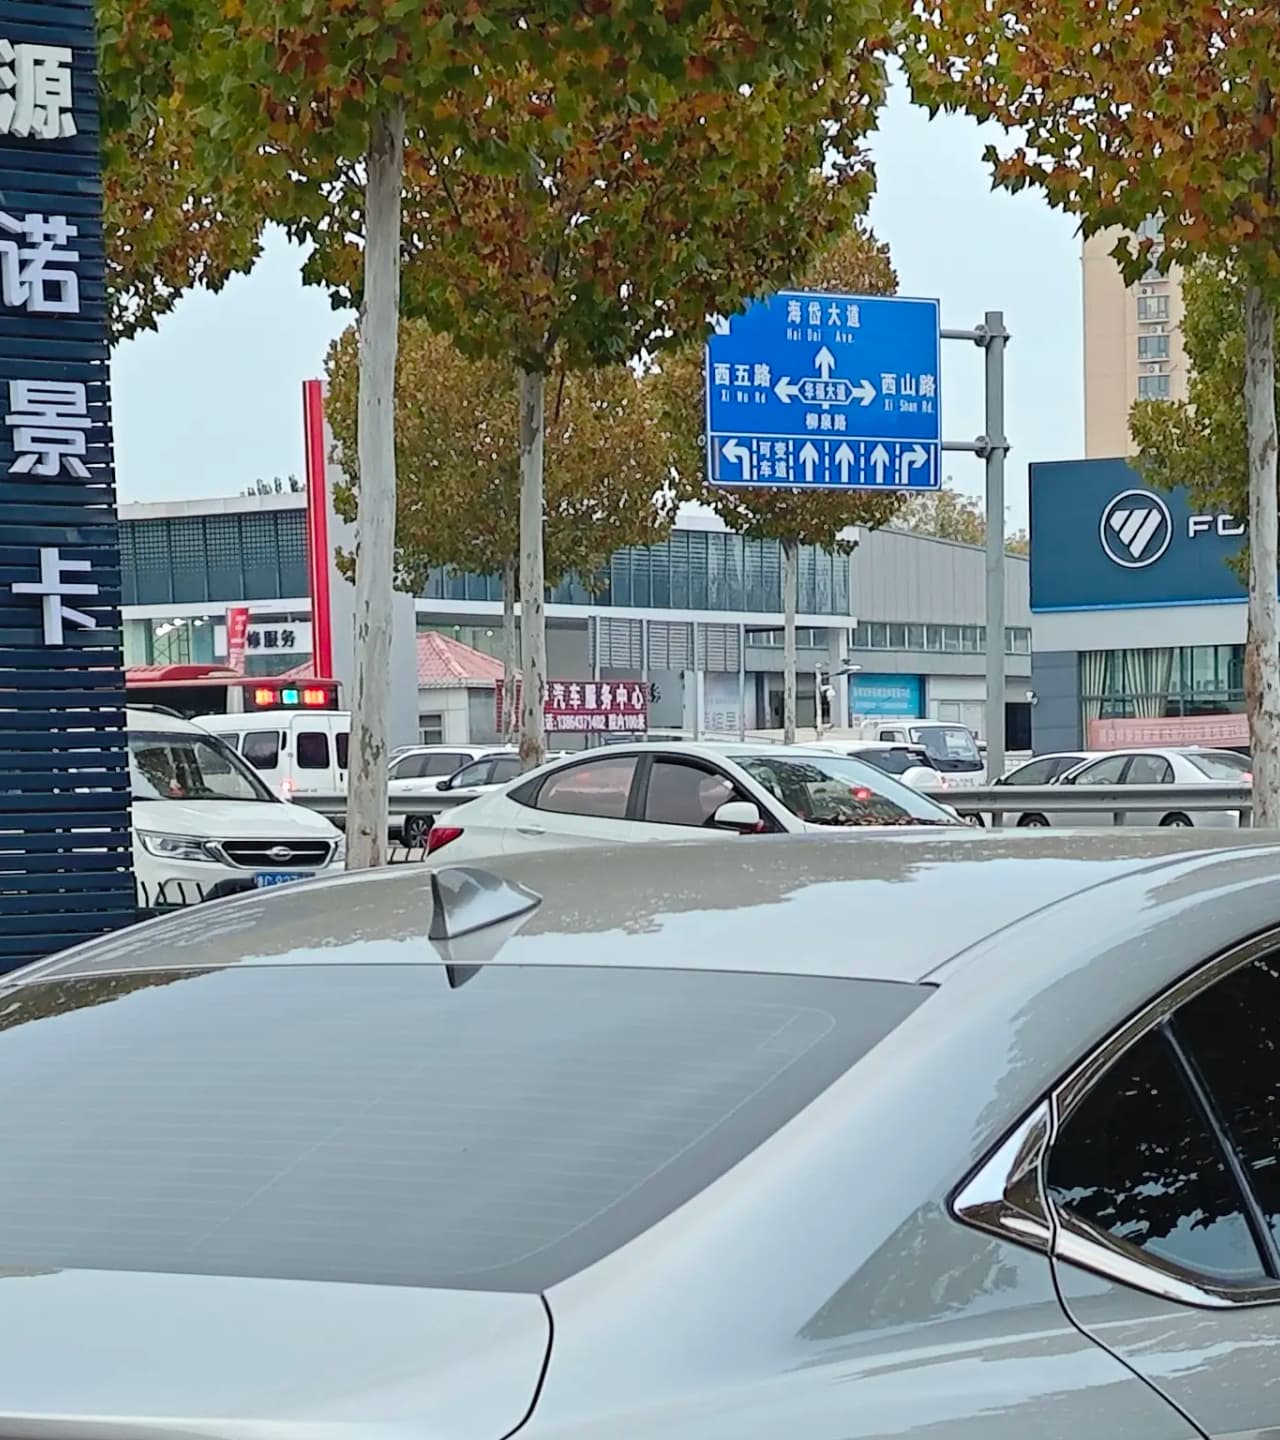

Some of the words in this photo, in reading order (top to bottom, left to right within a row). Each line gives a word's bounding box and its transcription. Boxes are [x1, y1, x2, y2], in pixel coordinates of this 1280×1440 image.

[787, 300, 861, 328] 海岱大道
[787, 328, 802, 341] Hai
[807, 329, 821, 342] Dai
[835, 331, 855, 343] Ave.
[713, 363, 771, 387] 西五路
[804, 383, 847, 401] 华福大道
[880, 373, 936, 398] 西山路
[721, 389, 730, 402] Xi
[884, 398, 893, 411] Xi
[899, 399, 918, 412] Shan
[805, 413, 847, 431] 柳泉路
[759, 441, 787, 459] 可变
[759, 461, 788, 478] 车道
[545, 683, 644, 710] 汽车服务中心
